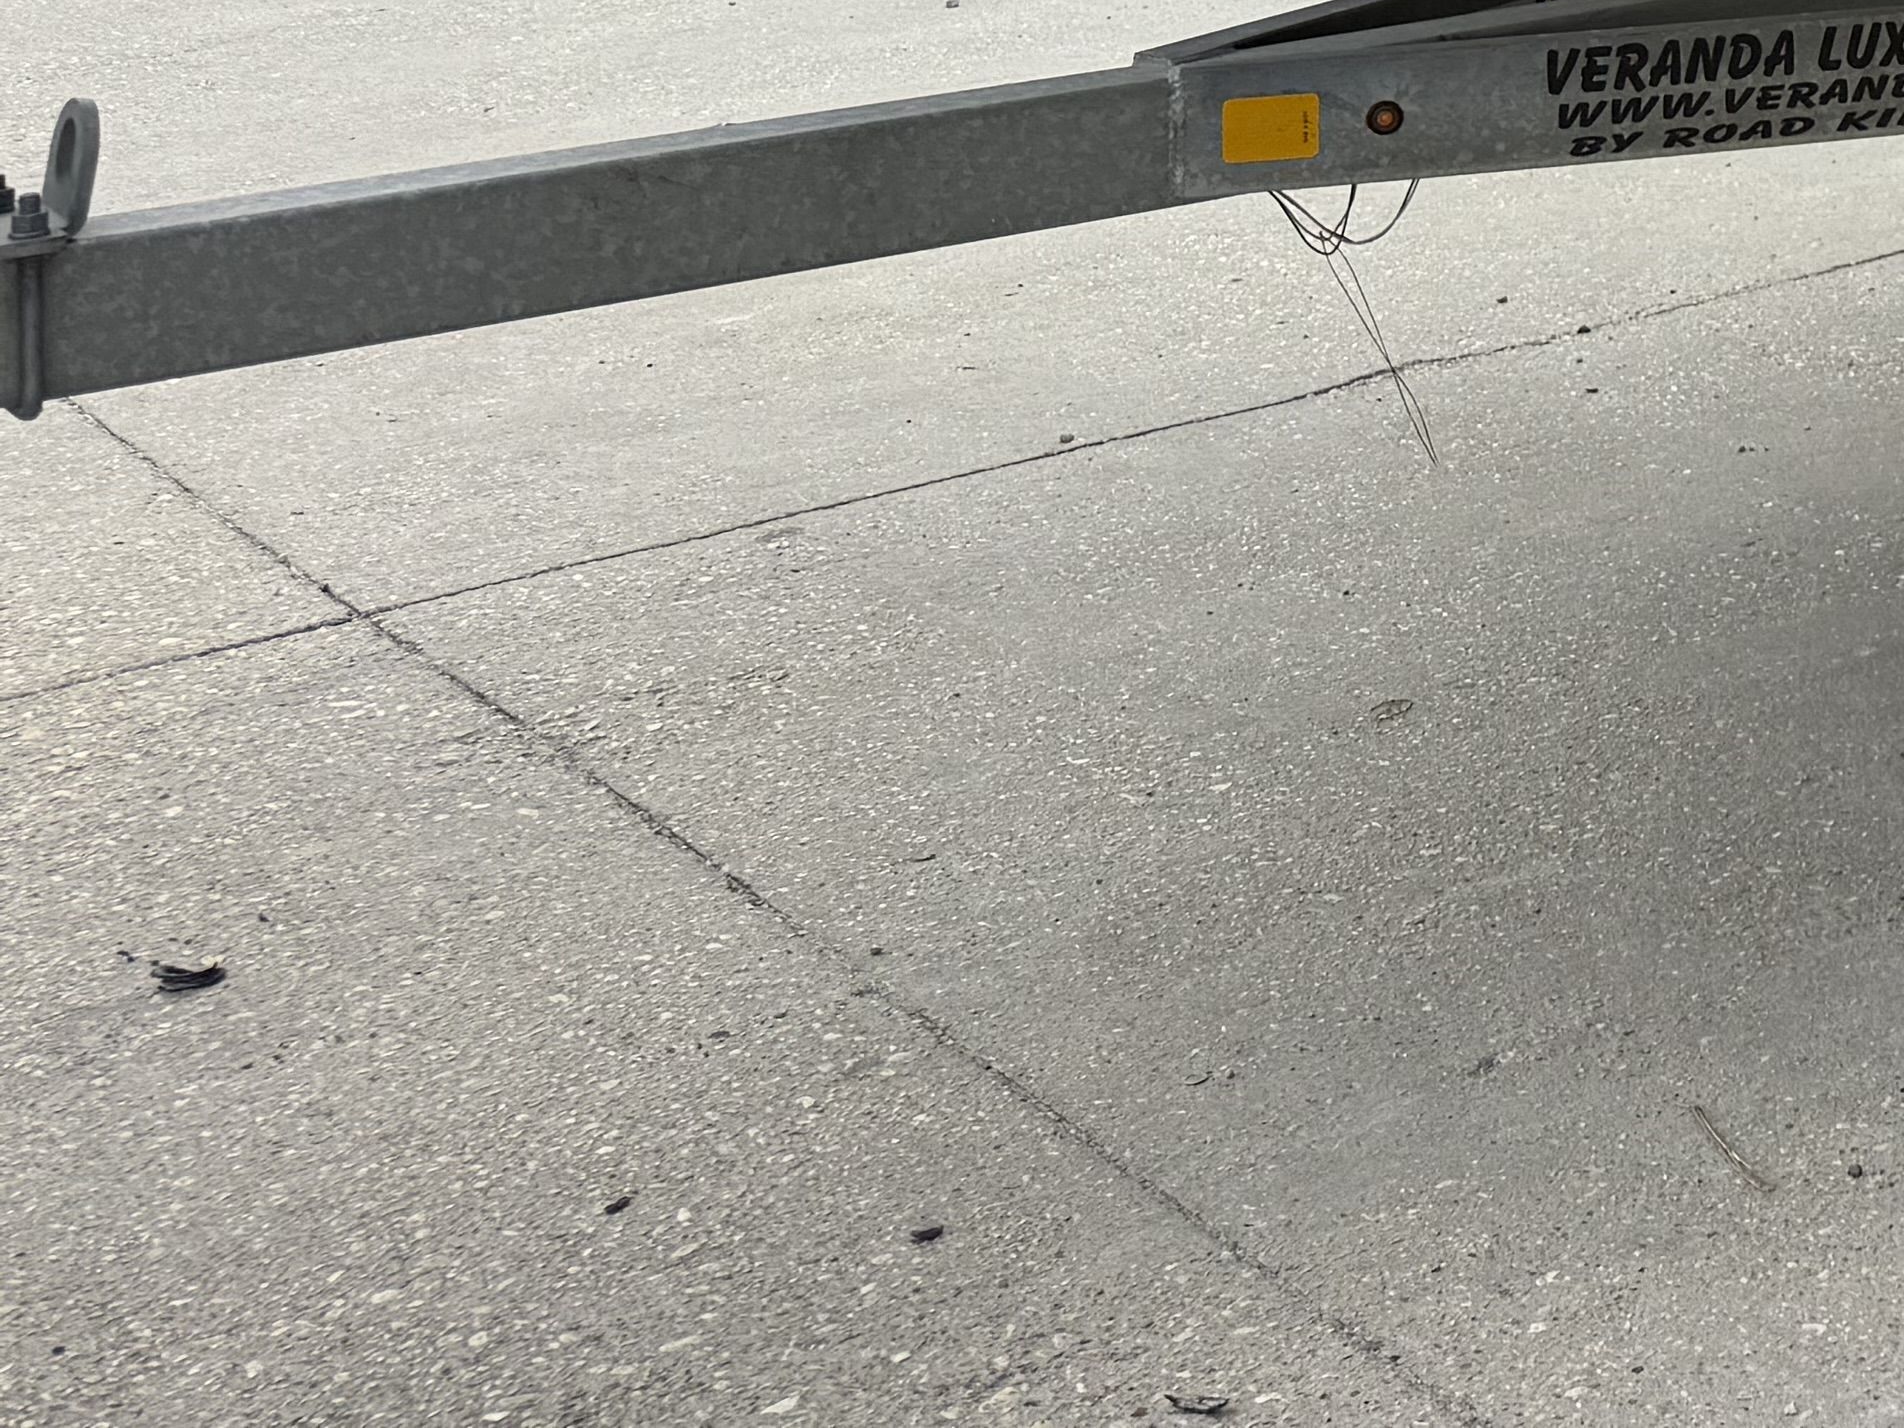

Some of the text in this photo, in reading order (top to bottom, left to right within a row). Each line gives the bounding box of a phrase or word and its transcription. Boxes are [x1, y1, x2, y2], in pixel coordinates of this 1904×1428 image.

[1546, 30, 1795, 95] VERANDA
[1569, 131, 1643, 157] BY
[1662, 116, 1815, 148] ROAD
